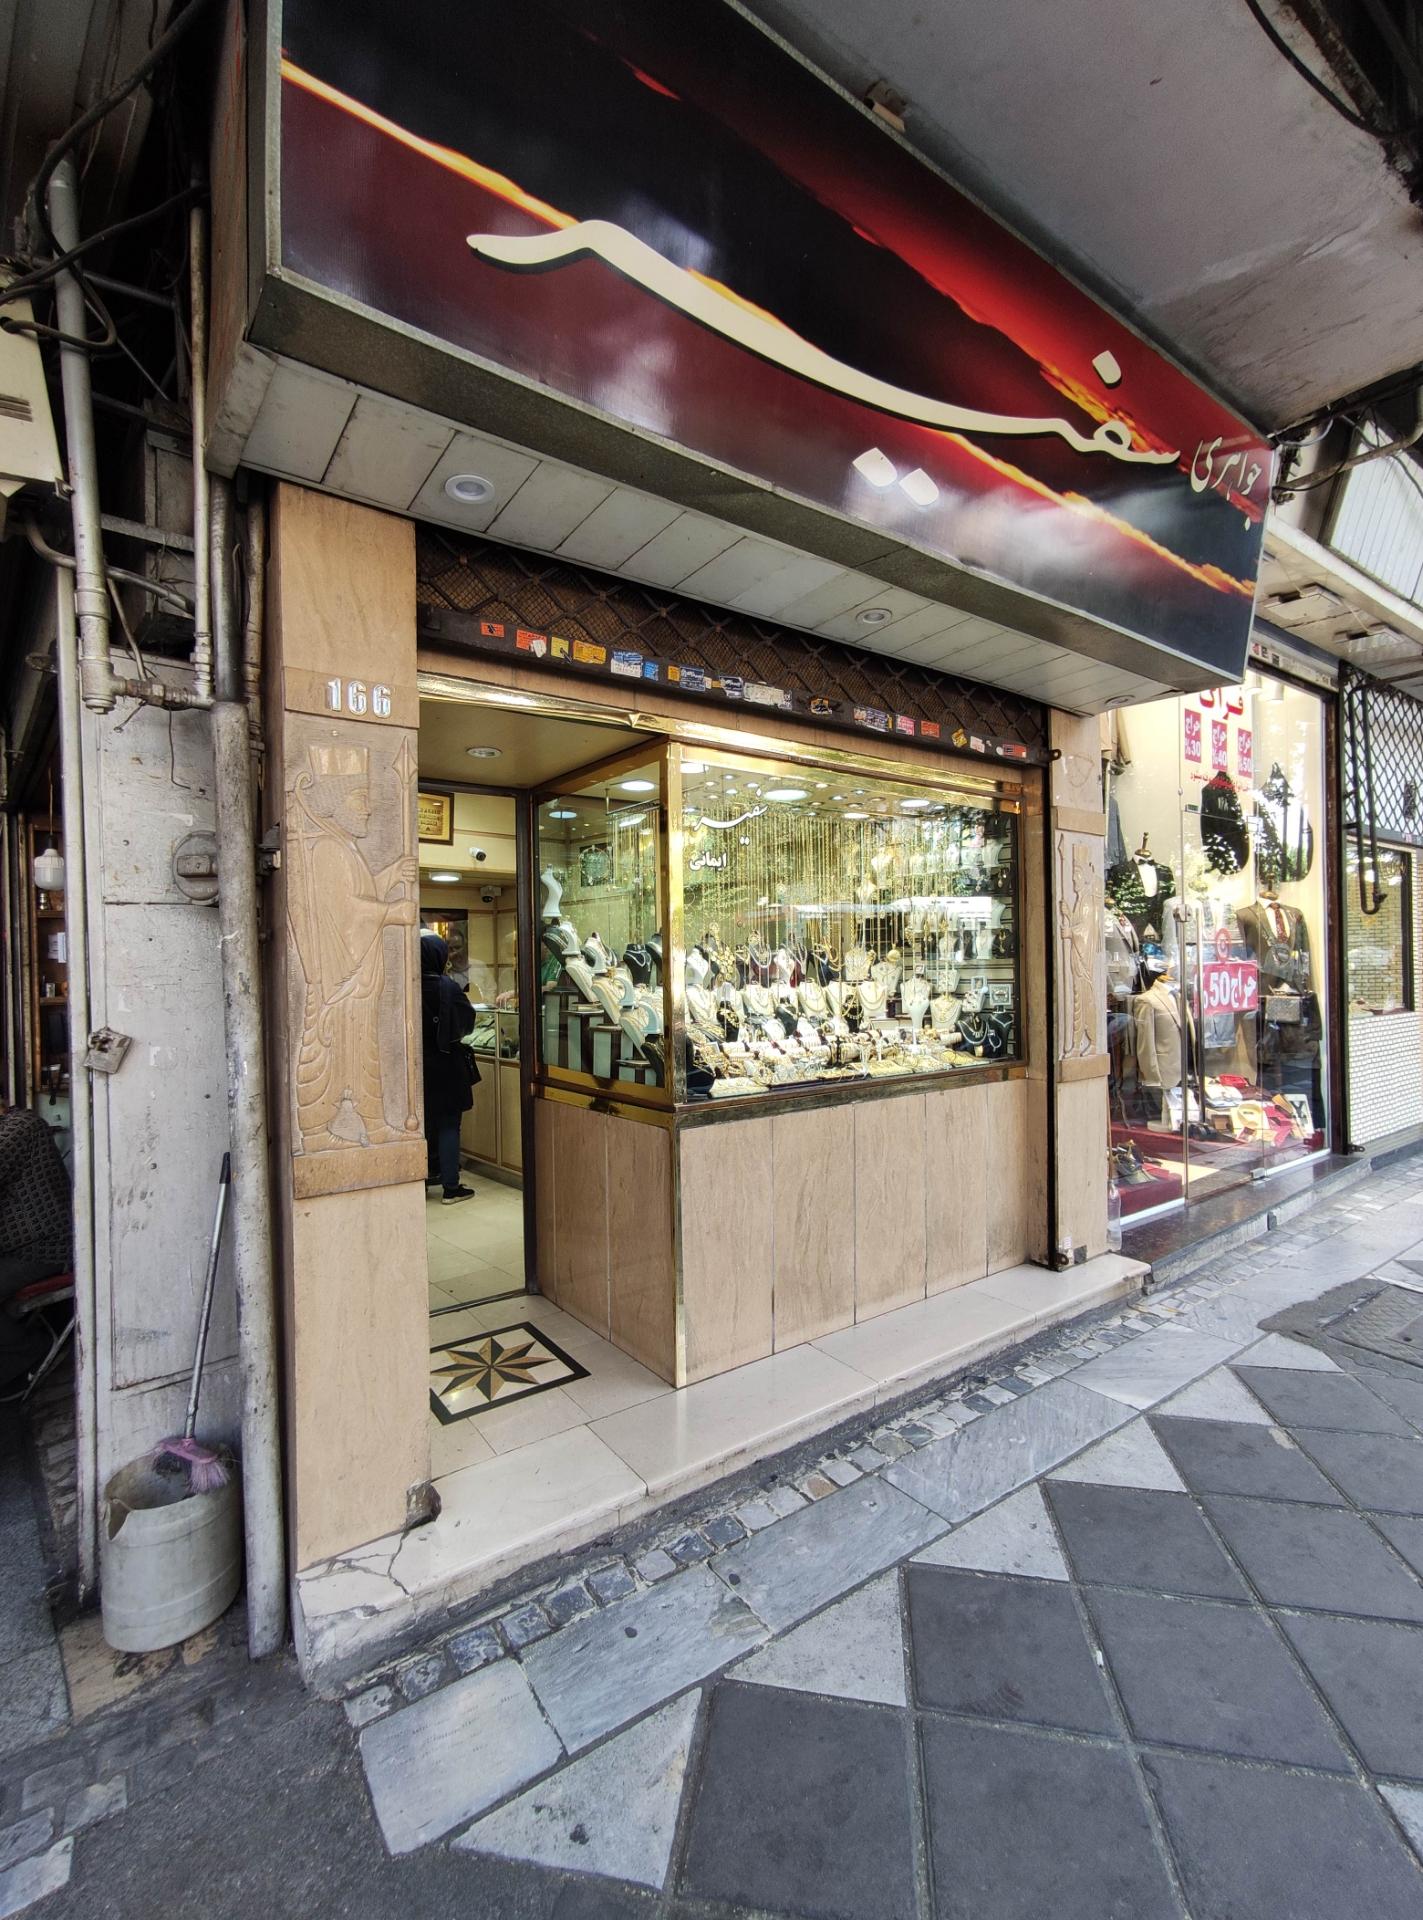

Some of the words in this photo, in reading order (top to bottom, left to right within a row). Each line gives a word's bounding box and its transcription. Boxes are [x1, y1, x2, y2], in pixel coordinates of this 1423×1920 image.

[466, 219, 1182, 507] سفیر
[1190, 436, 1262, 532] جواهری
[326, 677, 392, 719] 166
[1185, 714, 1200, 737] حراج
[693, 786, 769, 846] سفیر
[689, 850, 727, 871] ایمانی
[1231, 967, 1257, 1009] حراج
